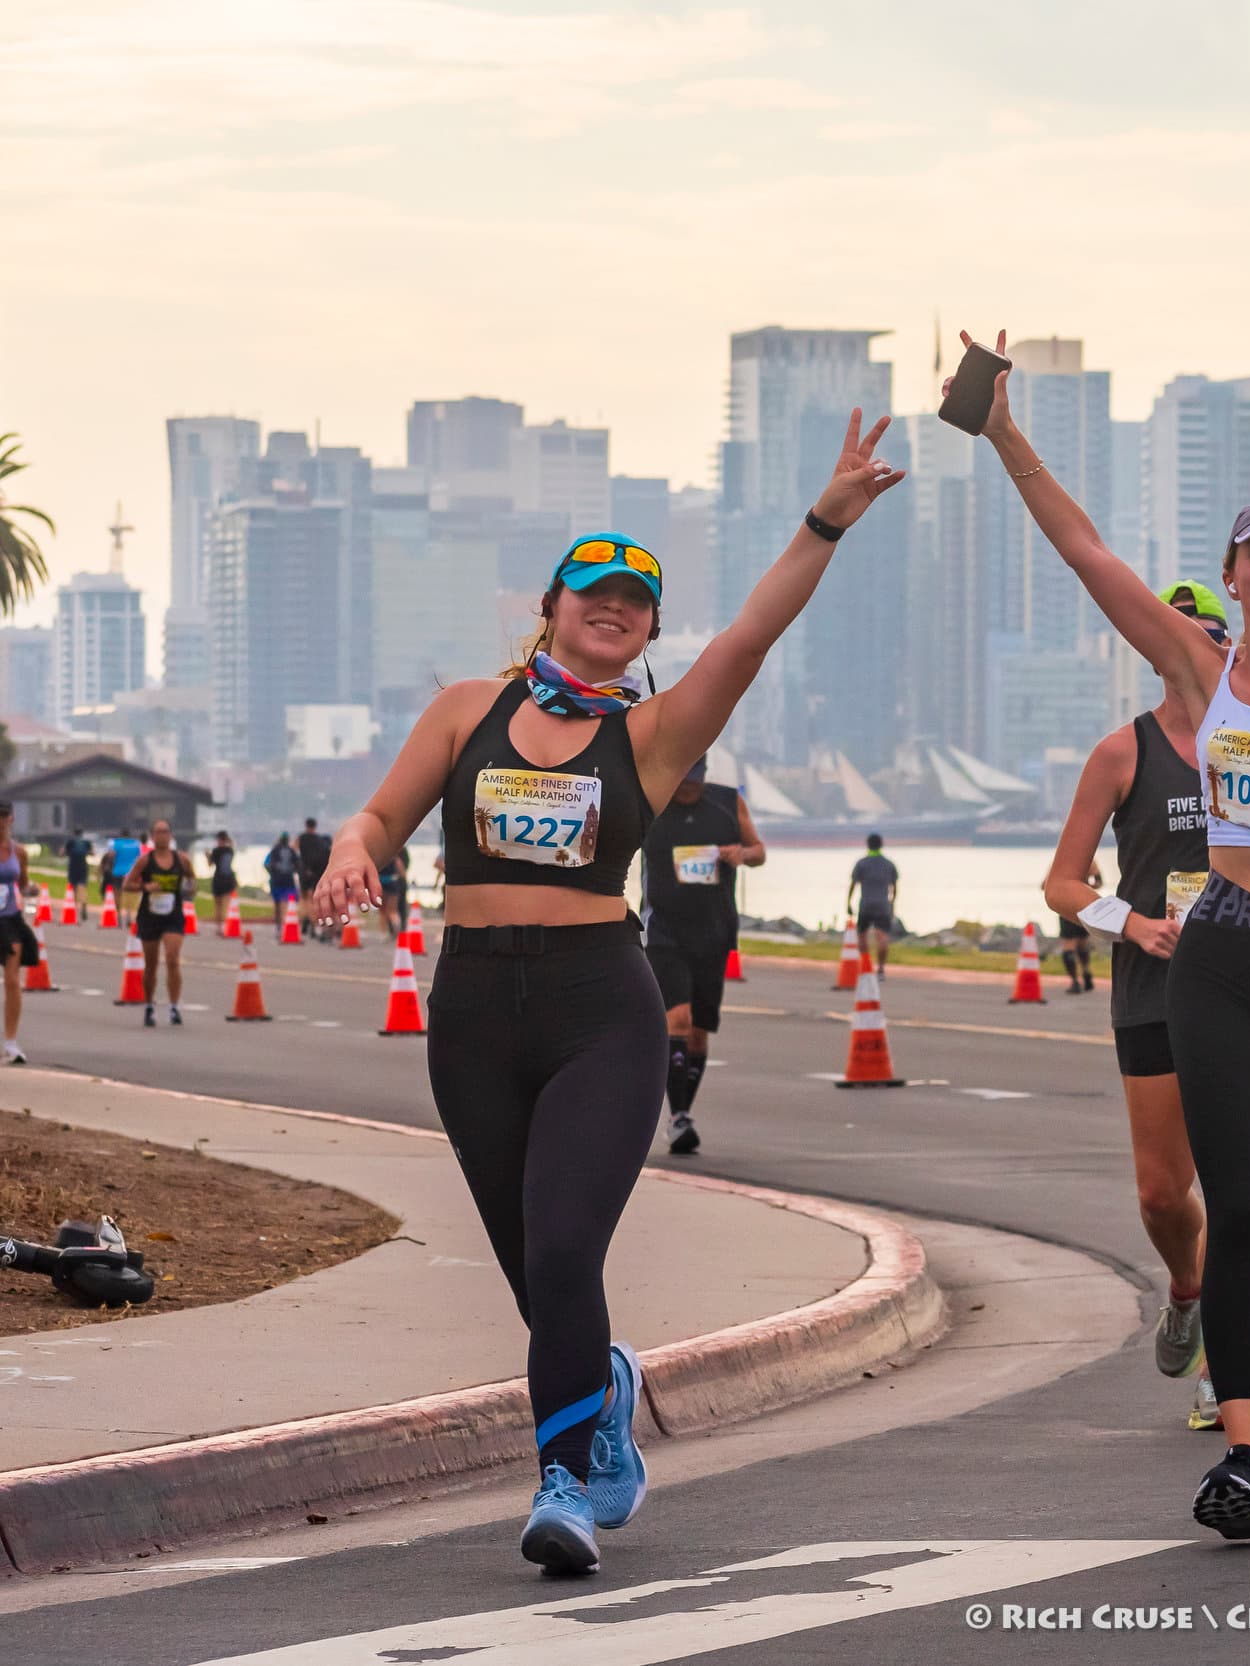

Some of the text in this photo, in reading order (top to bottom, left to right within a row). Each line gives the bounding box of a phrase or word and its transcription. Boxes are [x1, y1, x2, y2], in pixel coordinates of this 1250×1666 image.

[1223, 745, 1245, 756] HALF
[481, 774, 597, 793] AMERICA'S FINEST CITY
[495, 787, 582, 802] HALF MARATHON
[1167, 796, 1198, 814] FIVE
[492, 813, 583, 848] 1227
[1168, 814, 1207, 832] BREW
